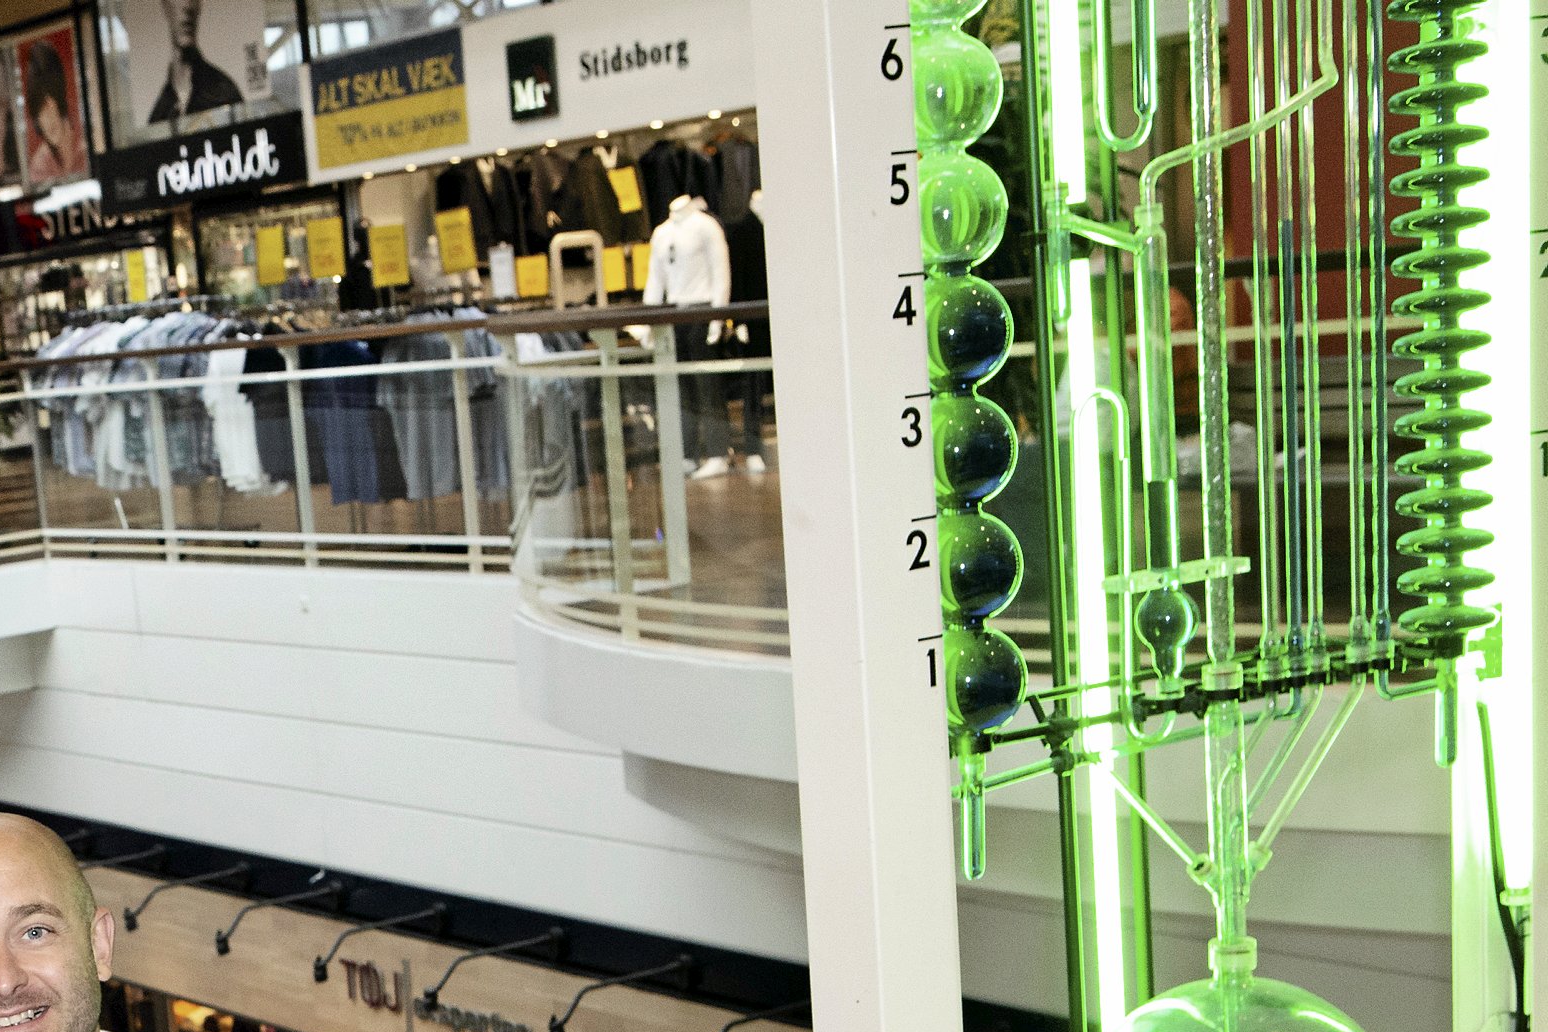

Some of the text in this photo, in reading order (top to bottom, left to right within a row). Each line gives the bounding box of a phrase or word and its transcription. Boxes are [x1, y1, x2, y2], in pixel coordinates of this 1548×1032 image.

[512, 38, 691, 113] Mr Stidsborg
[880, 38, 904, 81] 6
[316, 53, 458, 114] ALT SKAL VÆK
[890, 163, 910, 206] 5
[892, 285, 917, 326] 4
[901, 407, 923, 448] 3
[906, 529, 930, 571] 2
[927, 648, 937, 687] 1
